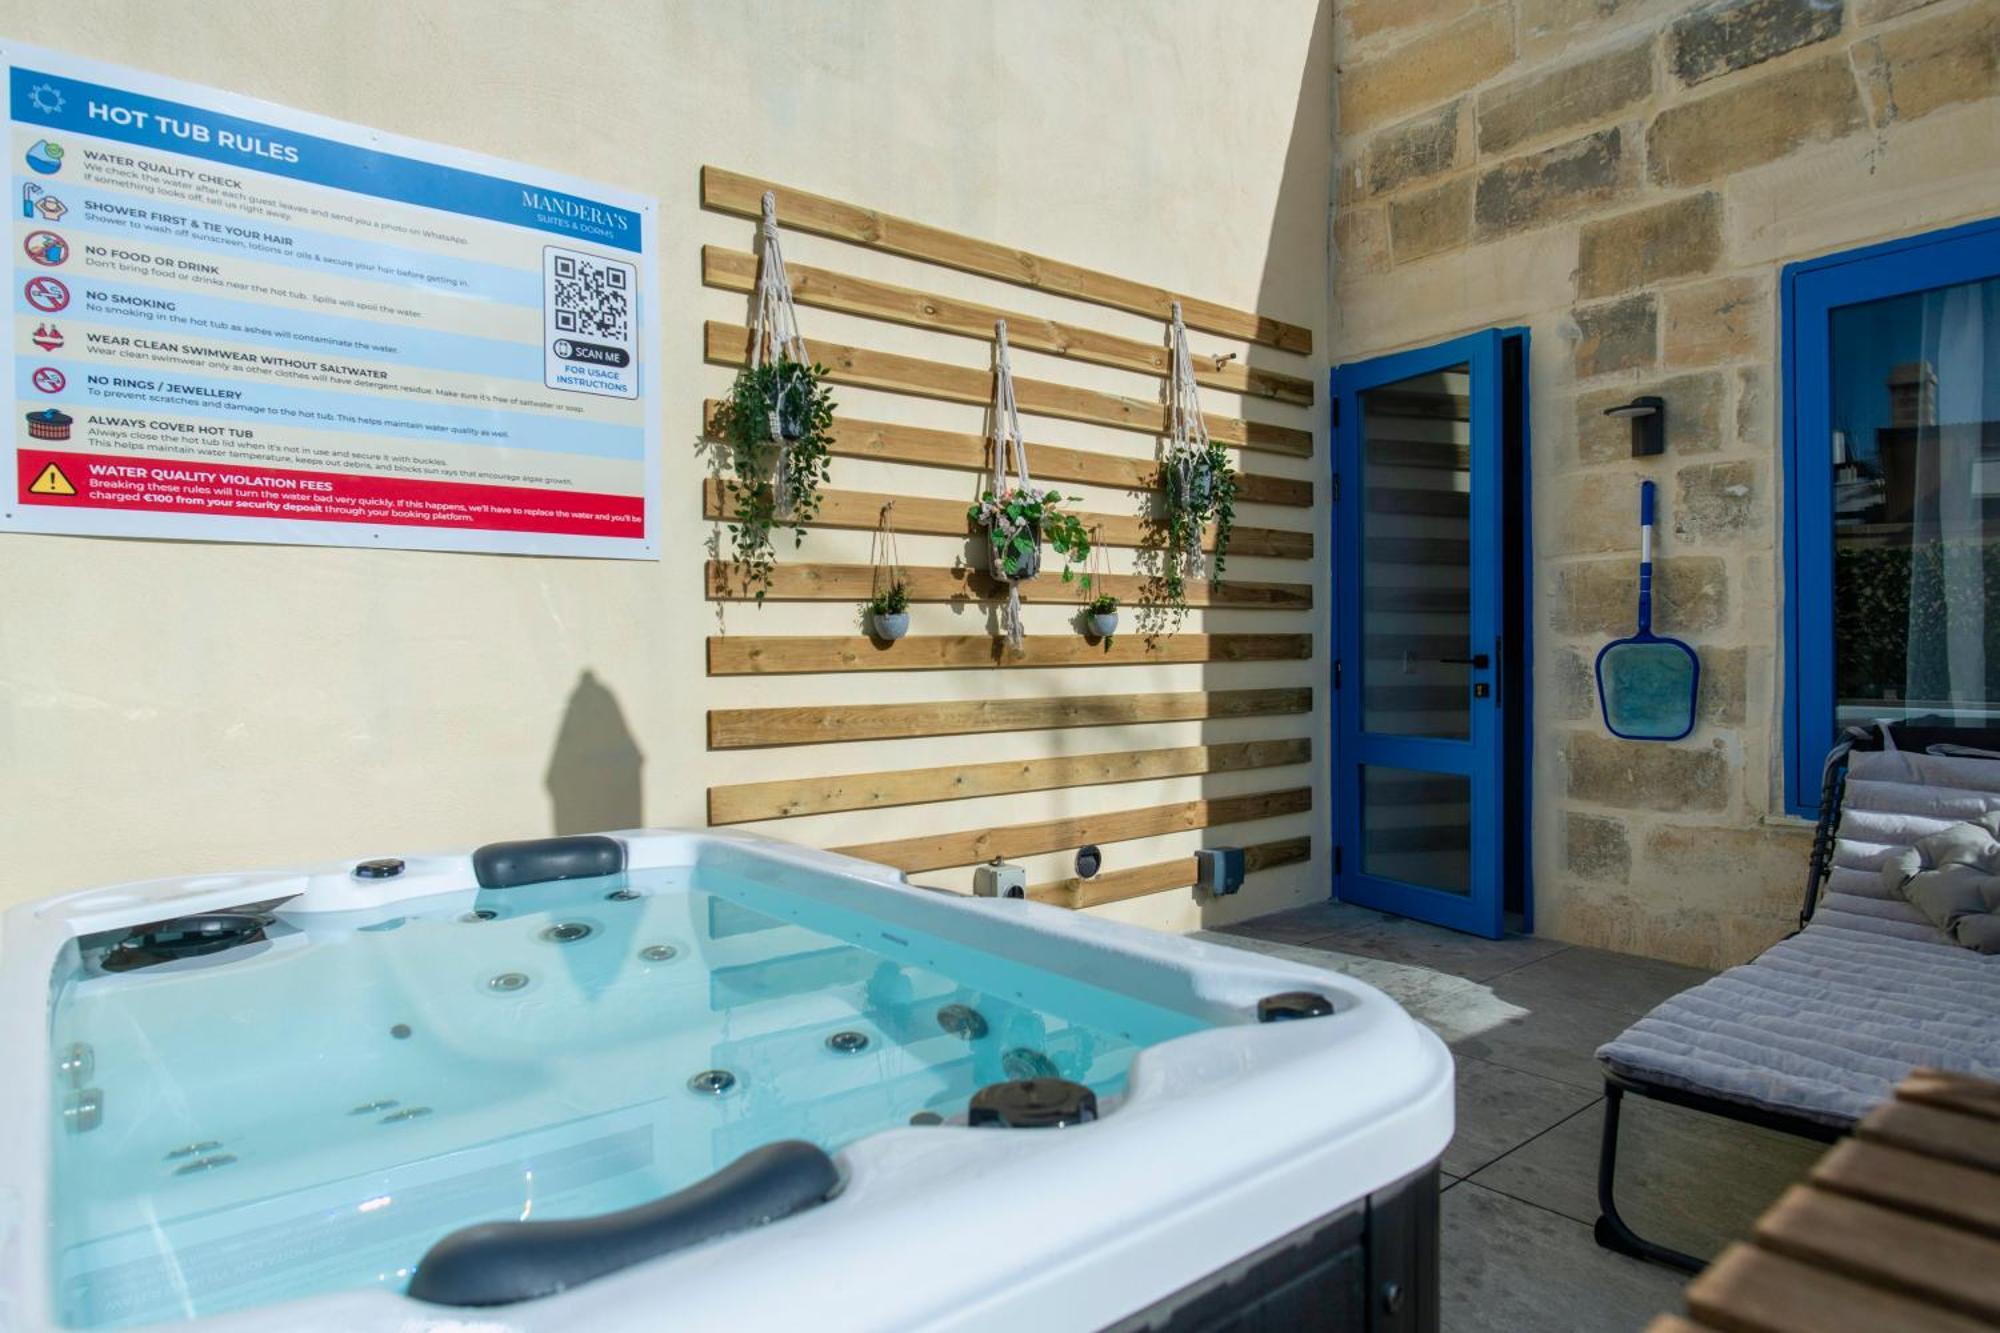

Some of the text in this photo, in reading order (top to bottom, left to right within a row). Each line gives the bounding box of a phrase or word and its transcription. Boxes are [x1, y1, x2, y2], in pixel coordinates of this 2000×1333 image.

[88, 101, 299, 164] HOT TUB RULES
[83, 149, 241, 189] WATER QUALITY CHECK
[94, 174, 154, 195] something
[157, 186, 185, 199] looks
[206, 196, 222, 206] tell
[239, 203, 263, 216] right
[105, 165, 138, 180] check
[141, 173, 159, 184] the
[162, 177, 192, 190] water
[196, 184, 218, 195] after
[221, 189, 245, 201] each
[248, 194, 276, 209] guest
[84, 200, 292, 246] SHOWER FIRST & TIE YOUR HAIR
[522, 191, 628, 230] MANDERA'S
[84, 212, 126, 226] Shower
[143, 222, 171, 234] wash
[174, 228, 188, 237] off
[249, 242, 281, 254] lotions
[536, 214, 614, 239] SUITES & DORMS
[85, 245, 219, 275] NO FOOD OR DRINK
[118, 262, 148, 276] bring
[151, 268, 175, 279] food
[191, 274, 223, 286] drinks
[226, 281, 248, 290] near
[251, 284, 267, 293] the
[86, 290, 175, 311] NO SMOKING
[105, 305, 153, 321] smoking
[169, 314, 187, 324] the
[190, 317, 207, 326] hot
[210, 320, 228, 329] tub
[86, 332, 387, 379] WEAR CLEAN SWIMWEAR WITHOUT SALTWATER
[87, 345, 116, 356] Wear
[119, 349, 148, 360] clean
[151, 353, 205, 367] swimwear
[208, 360, 230, 371] only
[245, 365, 271, 375] other
[274, 368, 309, 379] clothes
[575, 347, 620, 363] SCAN ME
[87, 374, 241, 400] NO RINGS / JEWELLERY
[556, 375, 627, 393] INSTRUCTIONS
[565, 365, 620, 380] FOR USAGE
[103, 388, 146, 402] prevent
[149, 393, 198, 406] scratches
[202, 399, 221, 408] and
[223, 401, 265, 415] damage
[280, 408, 296, 416] the
[87, 414, 253, 439] ALWAYS COVER HOT TUB
[87, 427, 127, 439] Always
[130, 431, 158, 440] close
[160, 434, 178, 442] the
[181, 435, 199, 444] hot
[201, 437, 219, 446] tub
[222, 439, 234, 447] lid
[236, 441, 265, 450] when
[88, 438, 111, 447] This
[114, 440, 144, 451] helps
[146, 443, 194, 454] maintain
[197, 447, 225, 456] water
[89, 464, 332, 491] WATER QUALITY VIOLATION FEES
[89, 478, 144, 492] Breaking
[147, 482, 180, 492] these
[182, 484, 211, 494] rules
[213, 487, 232, 495] will
[235, 488, 258, 497] turn
[261, 490, 279, 498] the
[280, 491, 310, 501] water
[313, 494, 333, 502] bad
[335, 497, 356, 506] very
[405, 500, 423, 508] this
[490, 506, 511, 514] have
[524, 508, 554, 519] replace
[555, 510, 569, 518] the
[571, 511, 593, 519] water
[89, 490, 140, 503] charged
[143, 494, 173, 503] €100
[176, 496, 204, 505] from
[206, 499, 233, 509] your
[235, 499, 280, 511] security
[282, 502, 322, 514] deposit
[325, 505, 365, 517] through
[367, 509, 389, 518] your
[390, 509, 430, 521] booking
